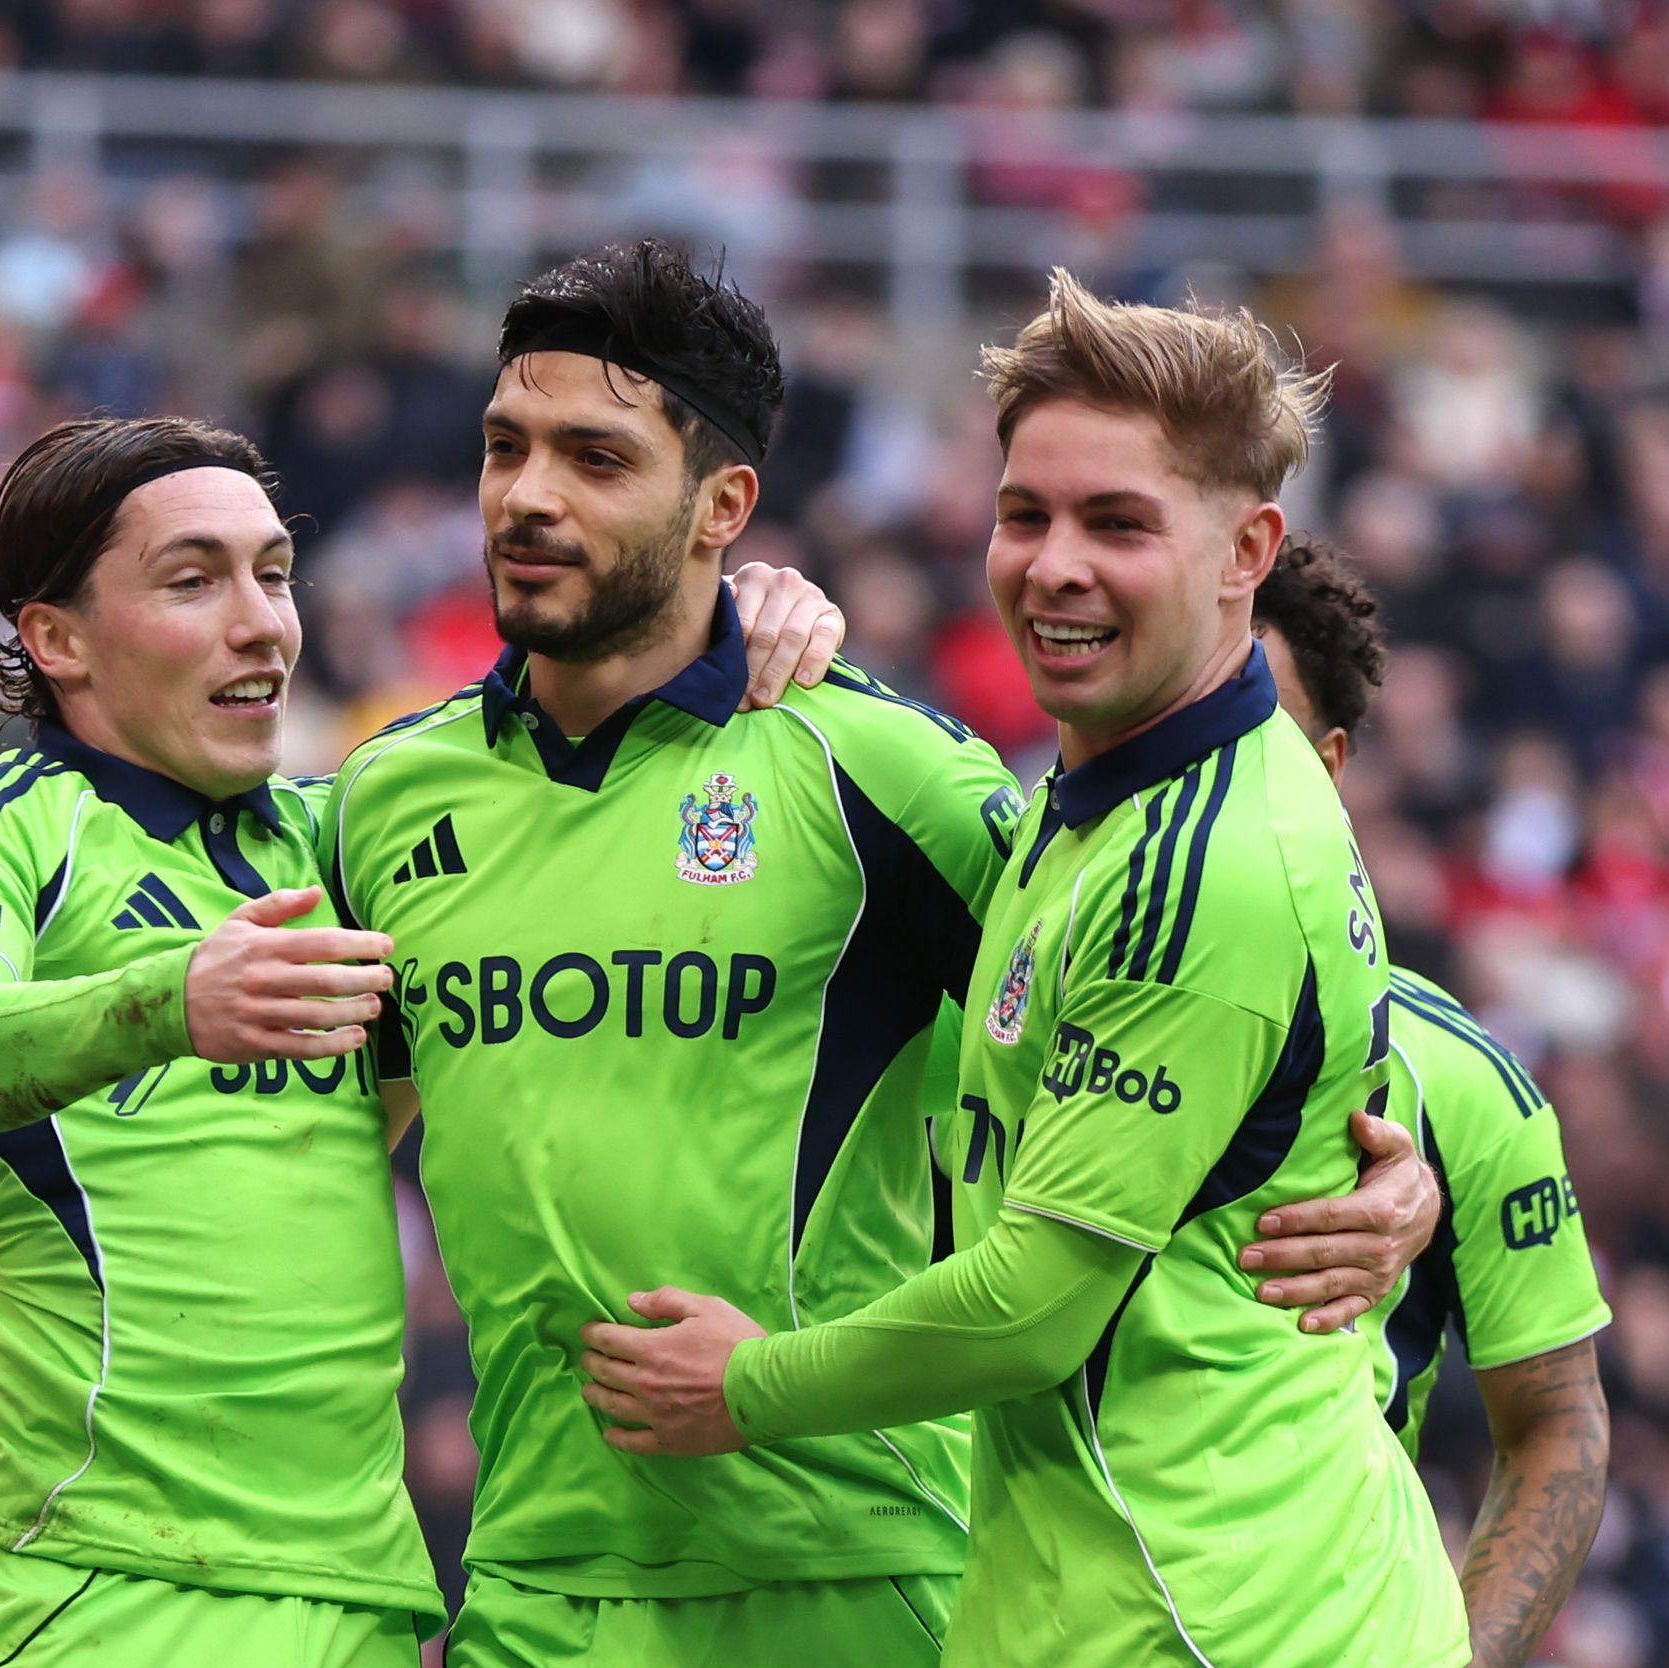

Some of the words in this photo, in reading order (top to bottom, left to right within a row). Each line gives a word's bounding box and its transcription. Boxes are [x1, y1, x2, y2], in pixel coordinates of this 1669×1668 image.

[681, 869, 728, 884] FULHAM
[435, 949, 777, 1049] SBOTOP
[869, 1505, 922, 1517] AEROREADY
